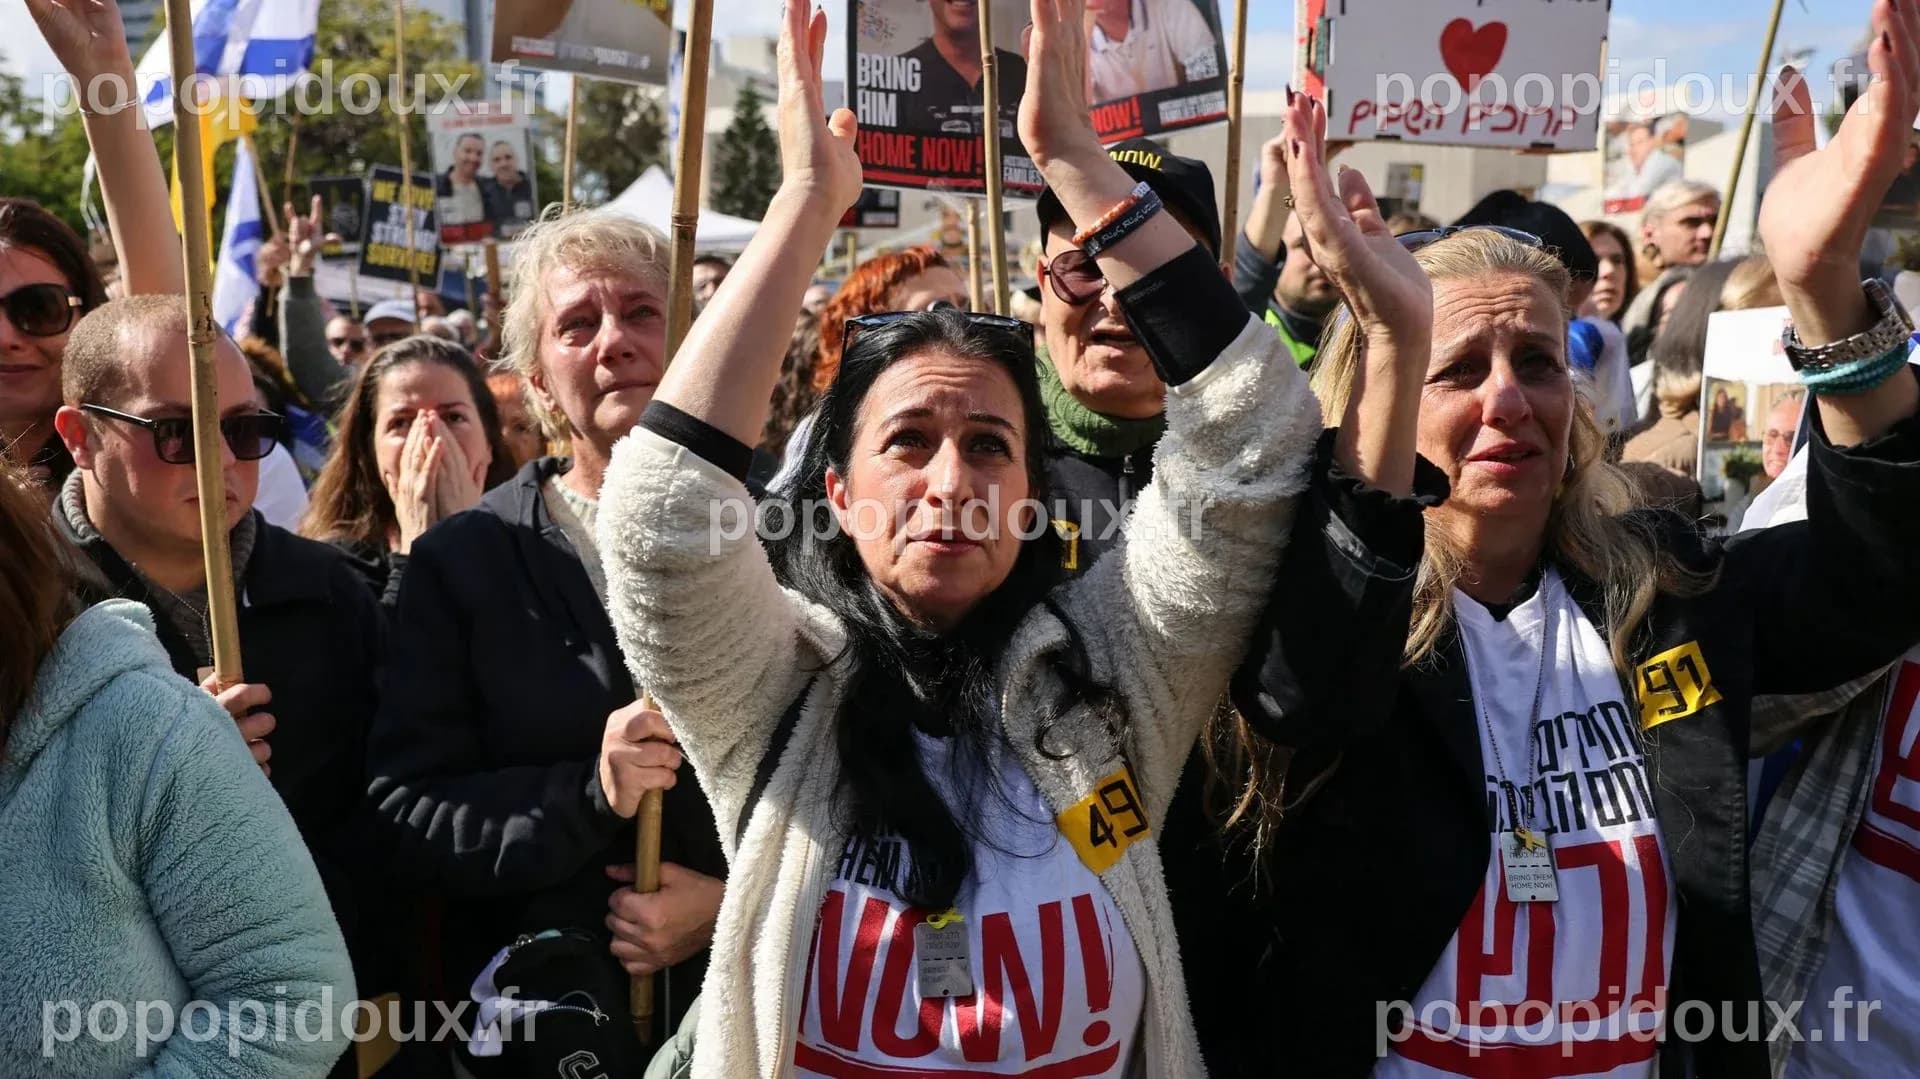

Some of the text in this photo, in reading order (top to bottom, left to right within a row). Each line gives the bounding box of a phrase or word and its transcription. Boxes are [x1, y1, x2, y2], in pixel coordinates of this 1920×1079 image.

[856, 52, 921, 93] BRING
[856, 89, 897, 127] HIM
[857, 130, 984, 175] HOME NOW!
[1640, 654, 1704, 715] 91
[798, 890, 1114, 1063] NOW!
